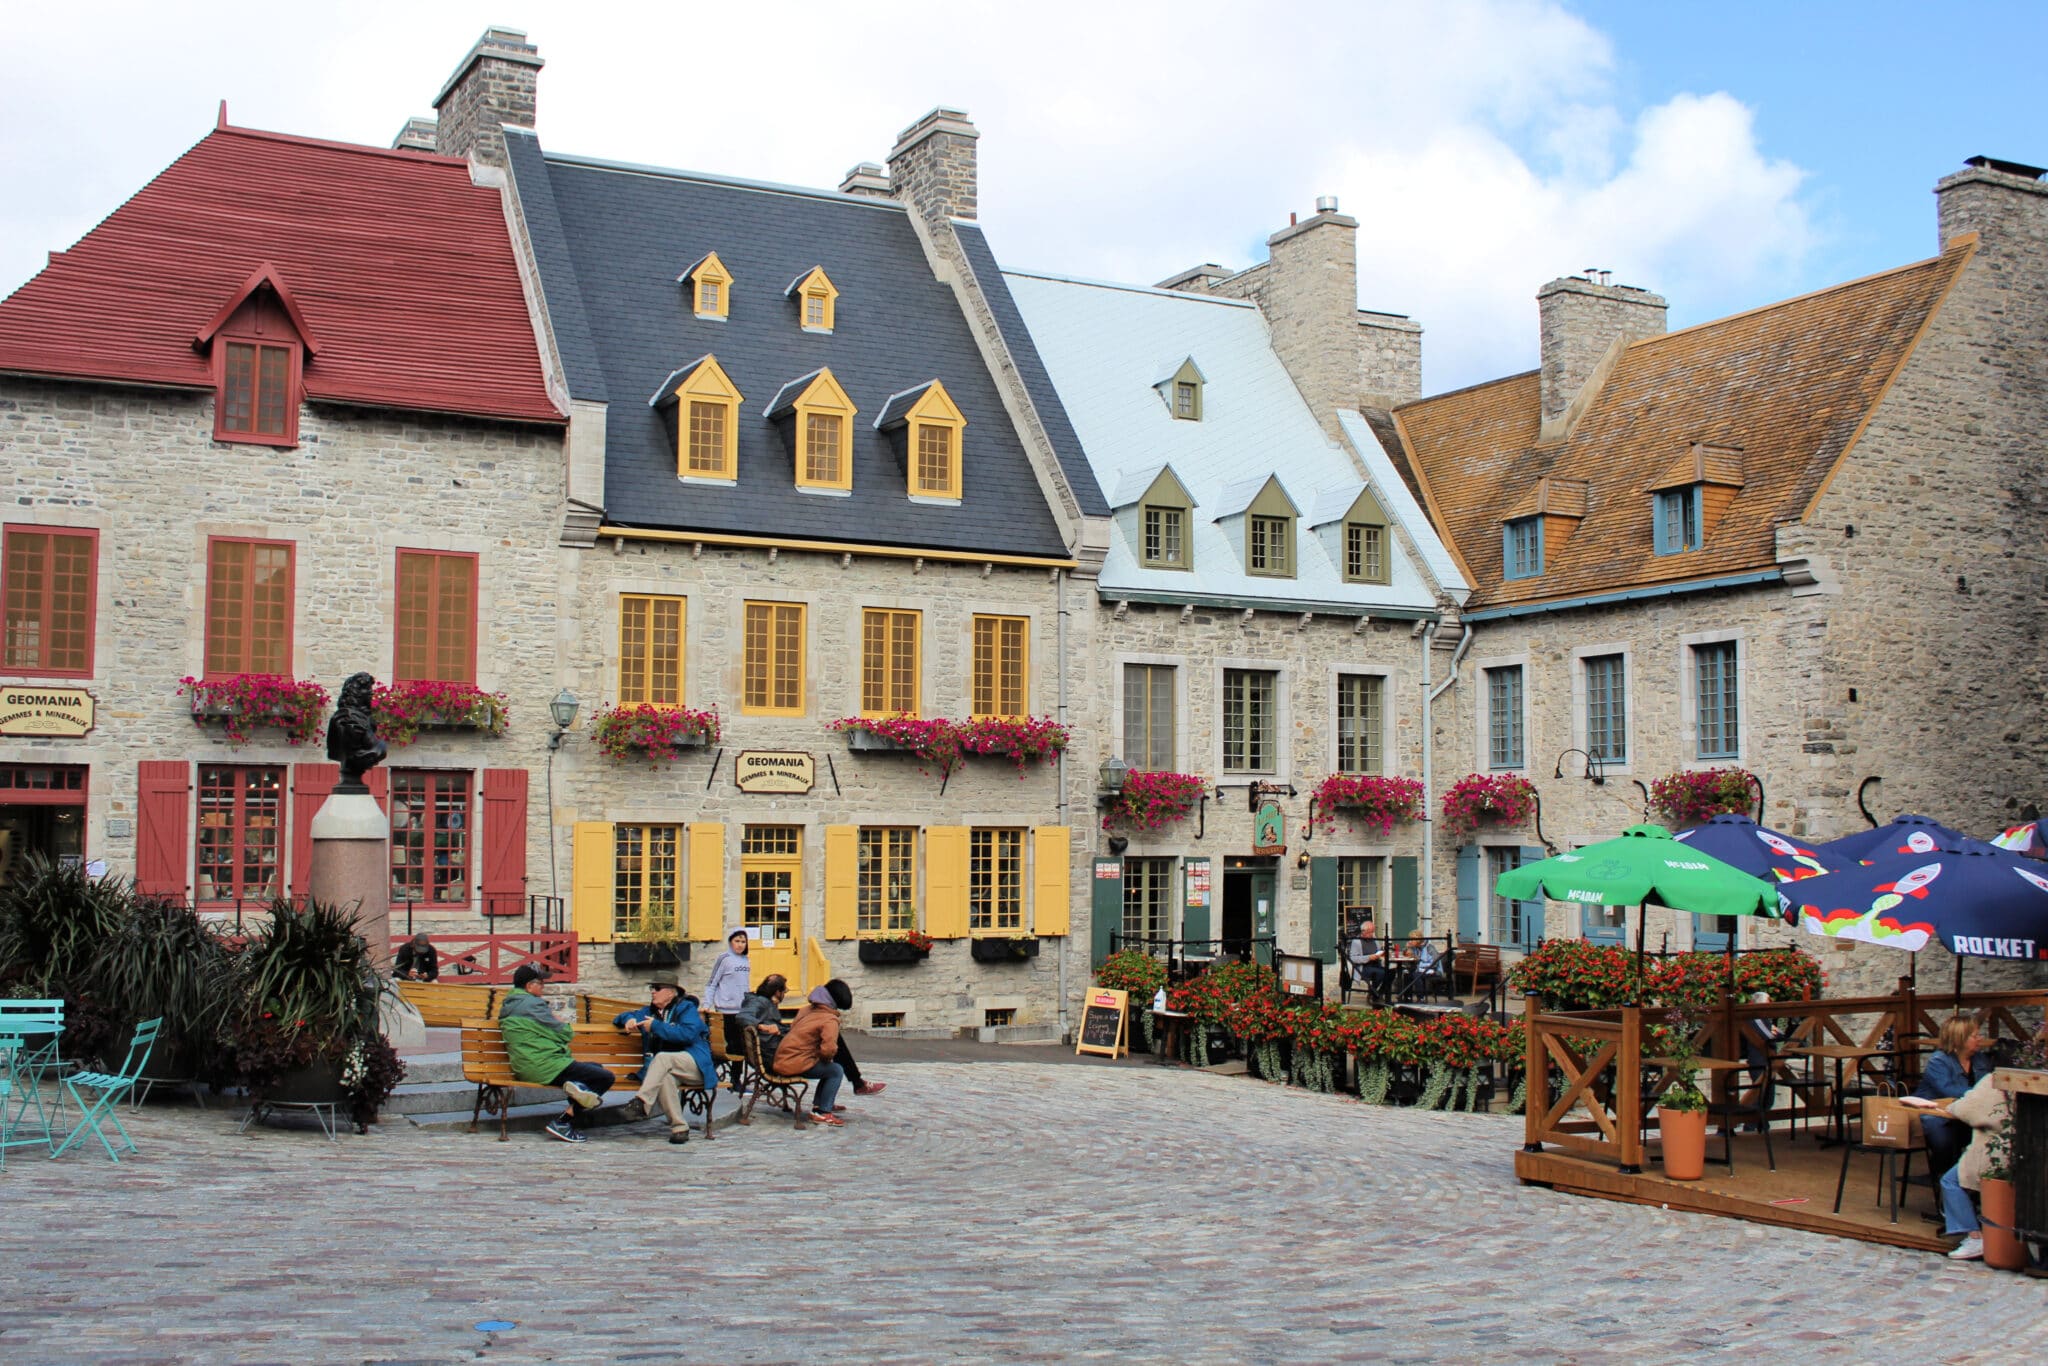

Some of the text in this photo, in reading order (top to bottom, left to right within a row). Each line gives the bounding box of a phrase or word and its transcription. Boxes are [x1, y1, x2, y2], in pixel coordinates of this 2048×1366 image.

[7, 694, 82, 707] GEOMANIA
[0, 710, 32, 725] GEMMES
[45, 710, 88, 728] MINERAUX
[747, 757, 804, 767] GEOMANIA
[740, 771, 767, 784] GEMMES
[776, 770, 809, 784] MINERAUX
[1567, 889, 1604, 903] McADAM
[1952, 934, 2036, 959] ROCKET
